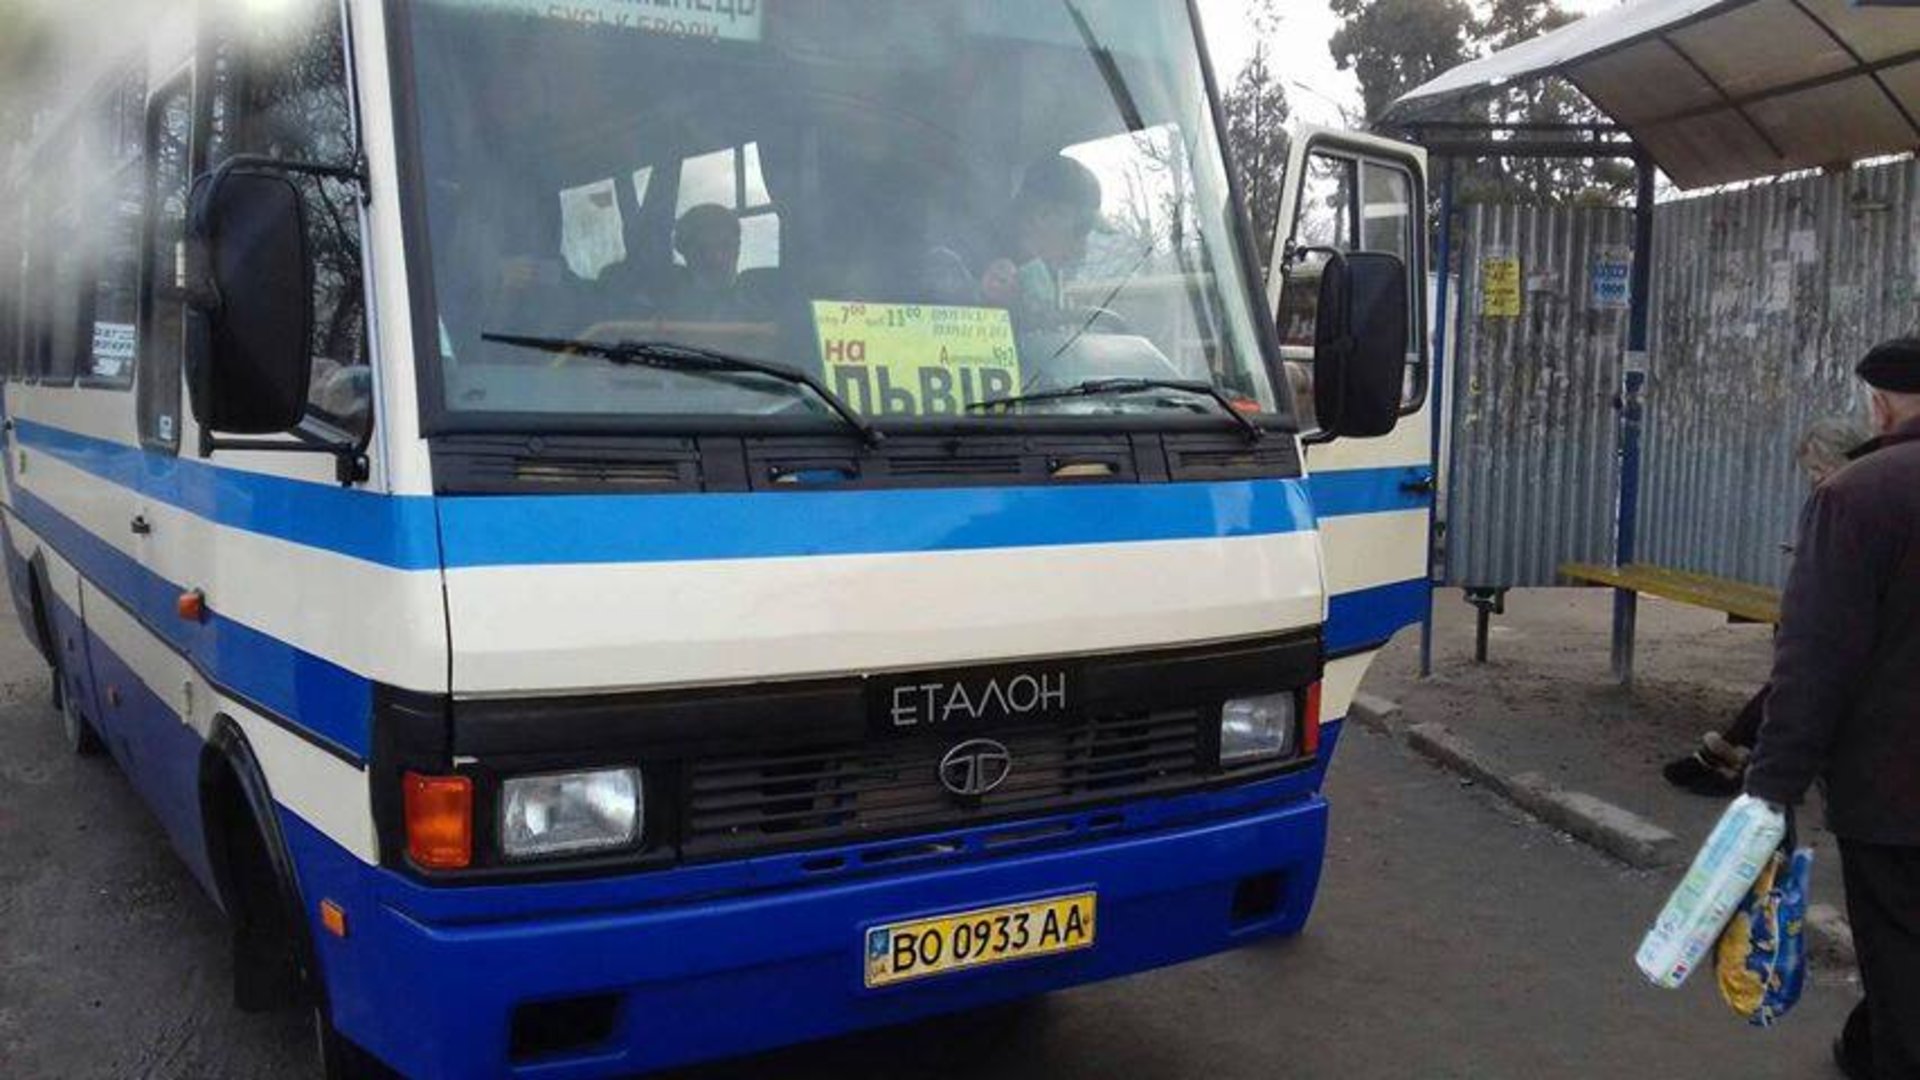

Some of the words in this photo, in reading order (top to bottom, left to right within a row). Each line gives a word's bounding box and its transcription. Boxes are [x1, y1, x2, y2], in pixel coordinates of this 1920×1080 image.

[824, 340, 866, 362] на
[891, 672, 1066, 726] ЕТАЛОН
[952, 912, 1030, 960] 0933
